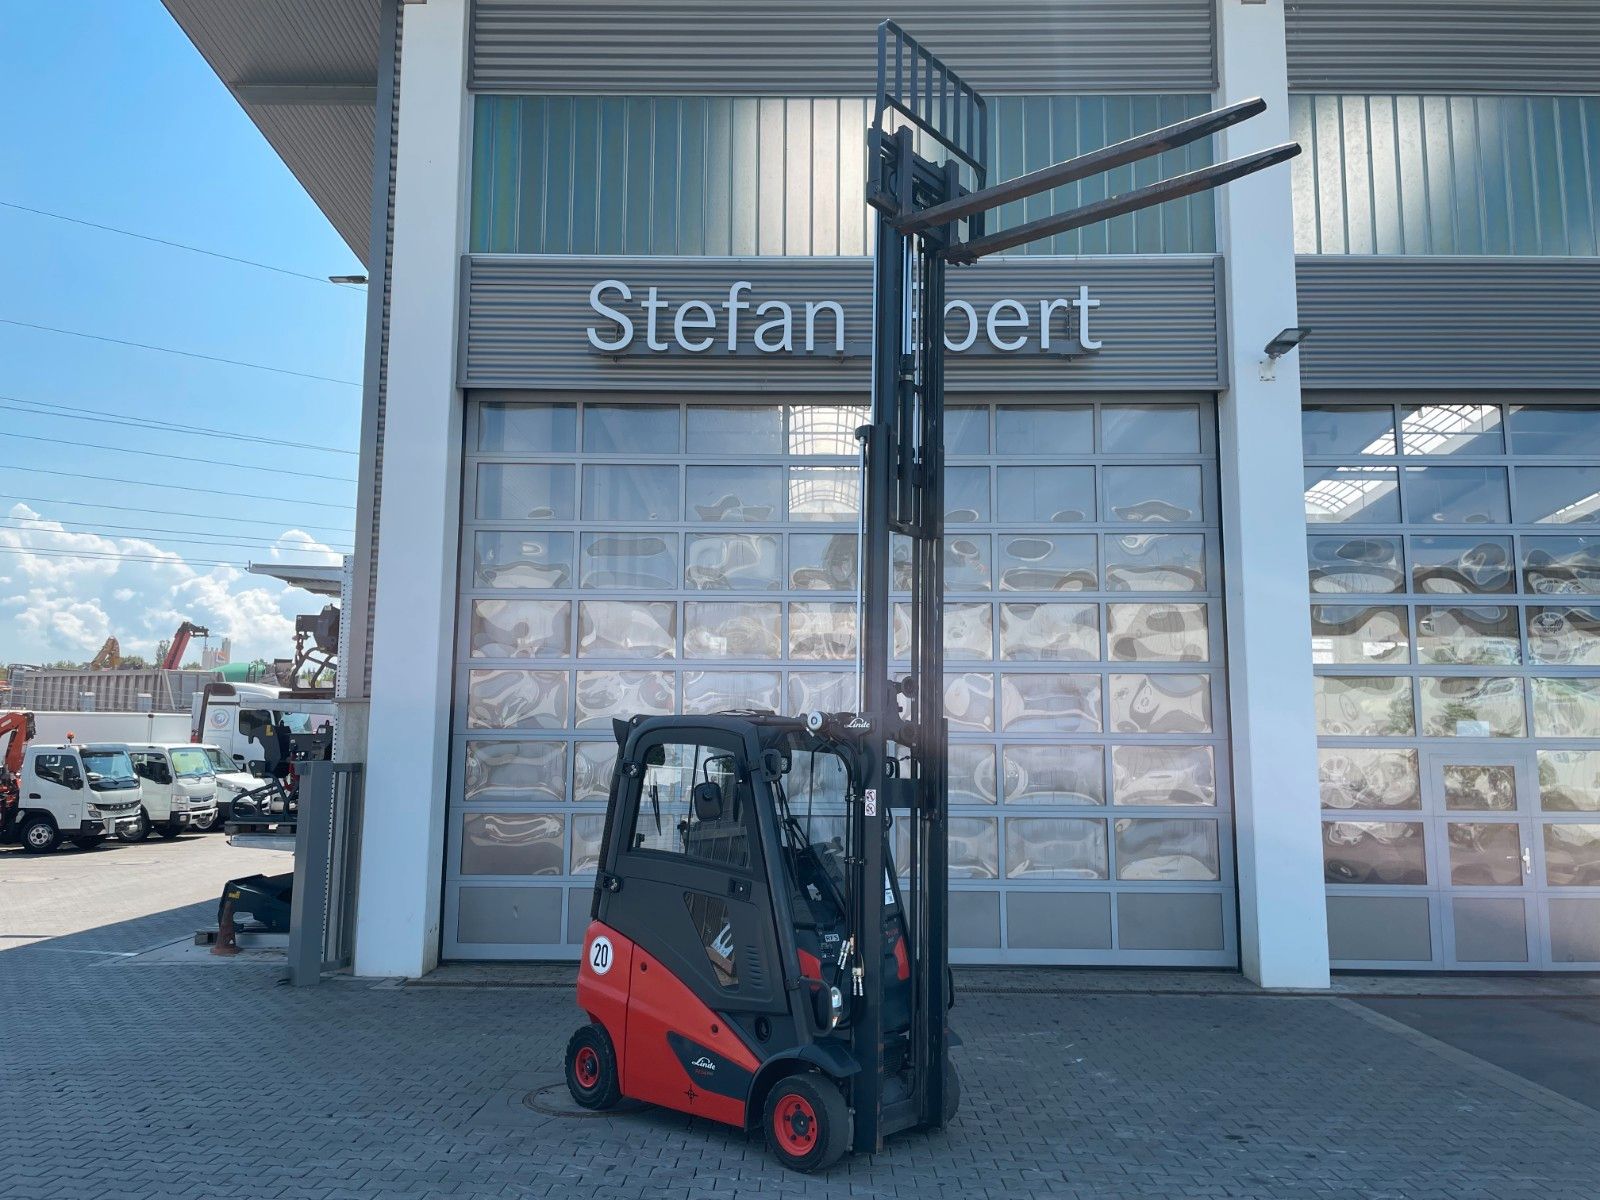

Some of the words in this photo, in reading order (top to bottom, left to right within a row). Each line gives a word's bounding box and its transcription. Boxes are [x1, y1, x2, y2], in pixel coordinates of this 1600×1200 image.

[586, 279, 844, 352] Stefan
[911, 282, 1102, 351] bert
[844, 717, 870, 728] Linde
[594, 943, 609, 967] 20
[691, 1056, 716, 1070] Linde
